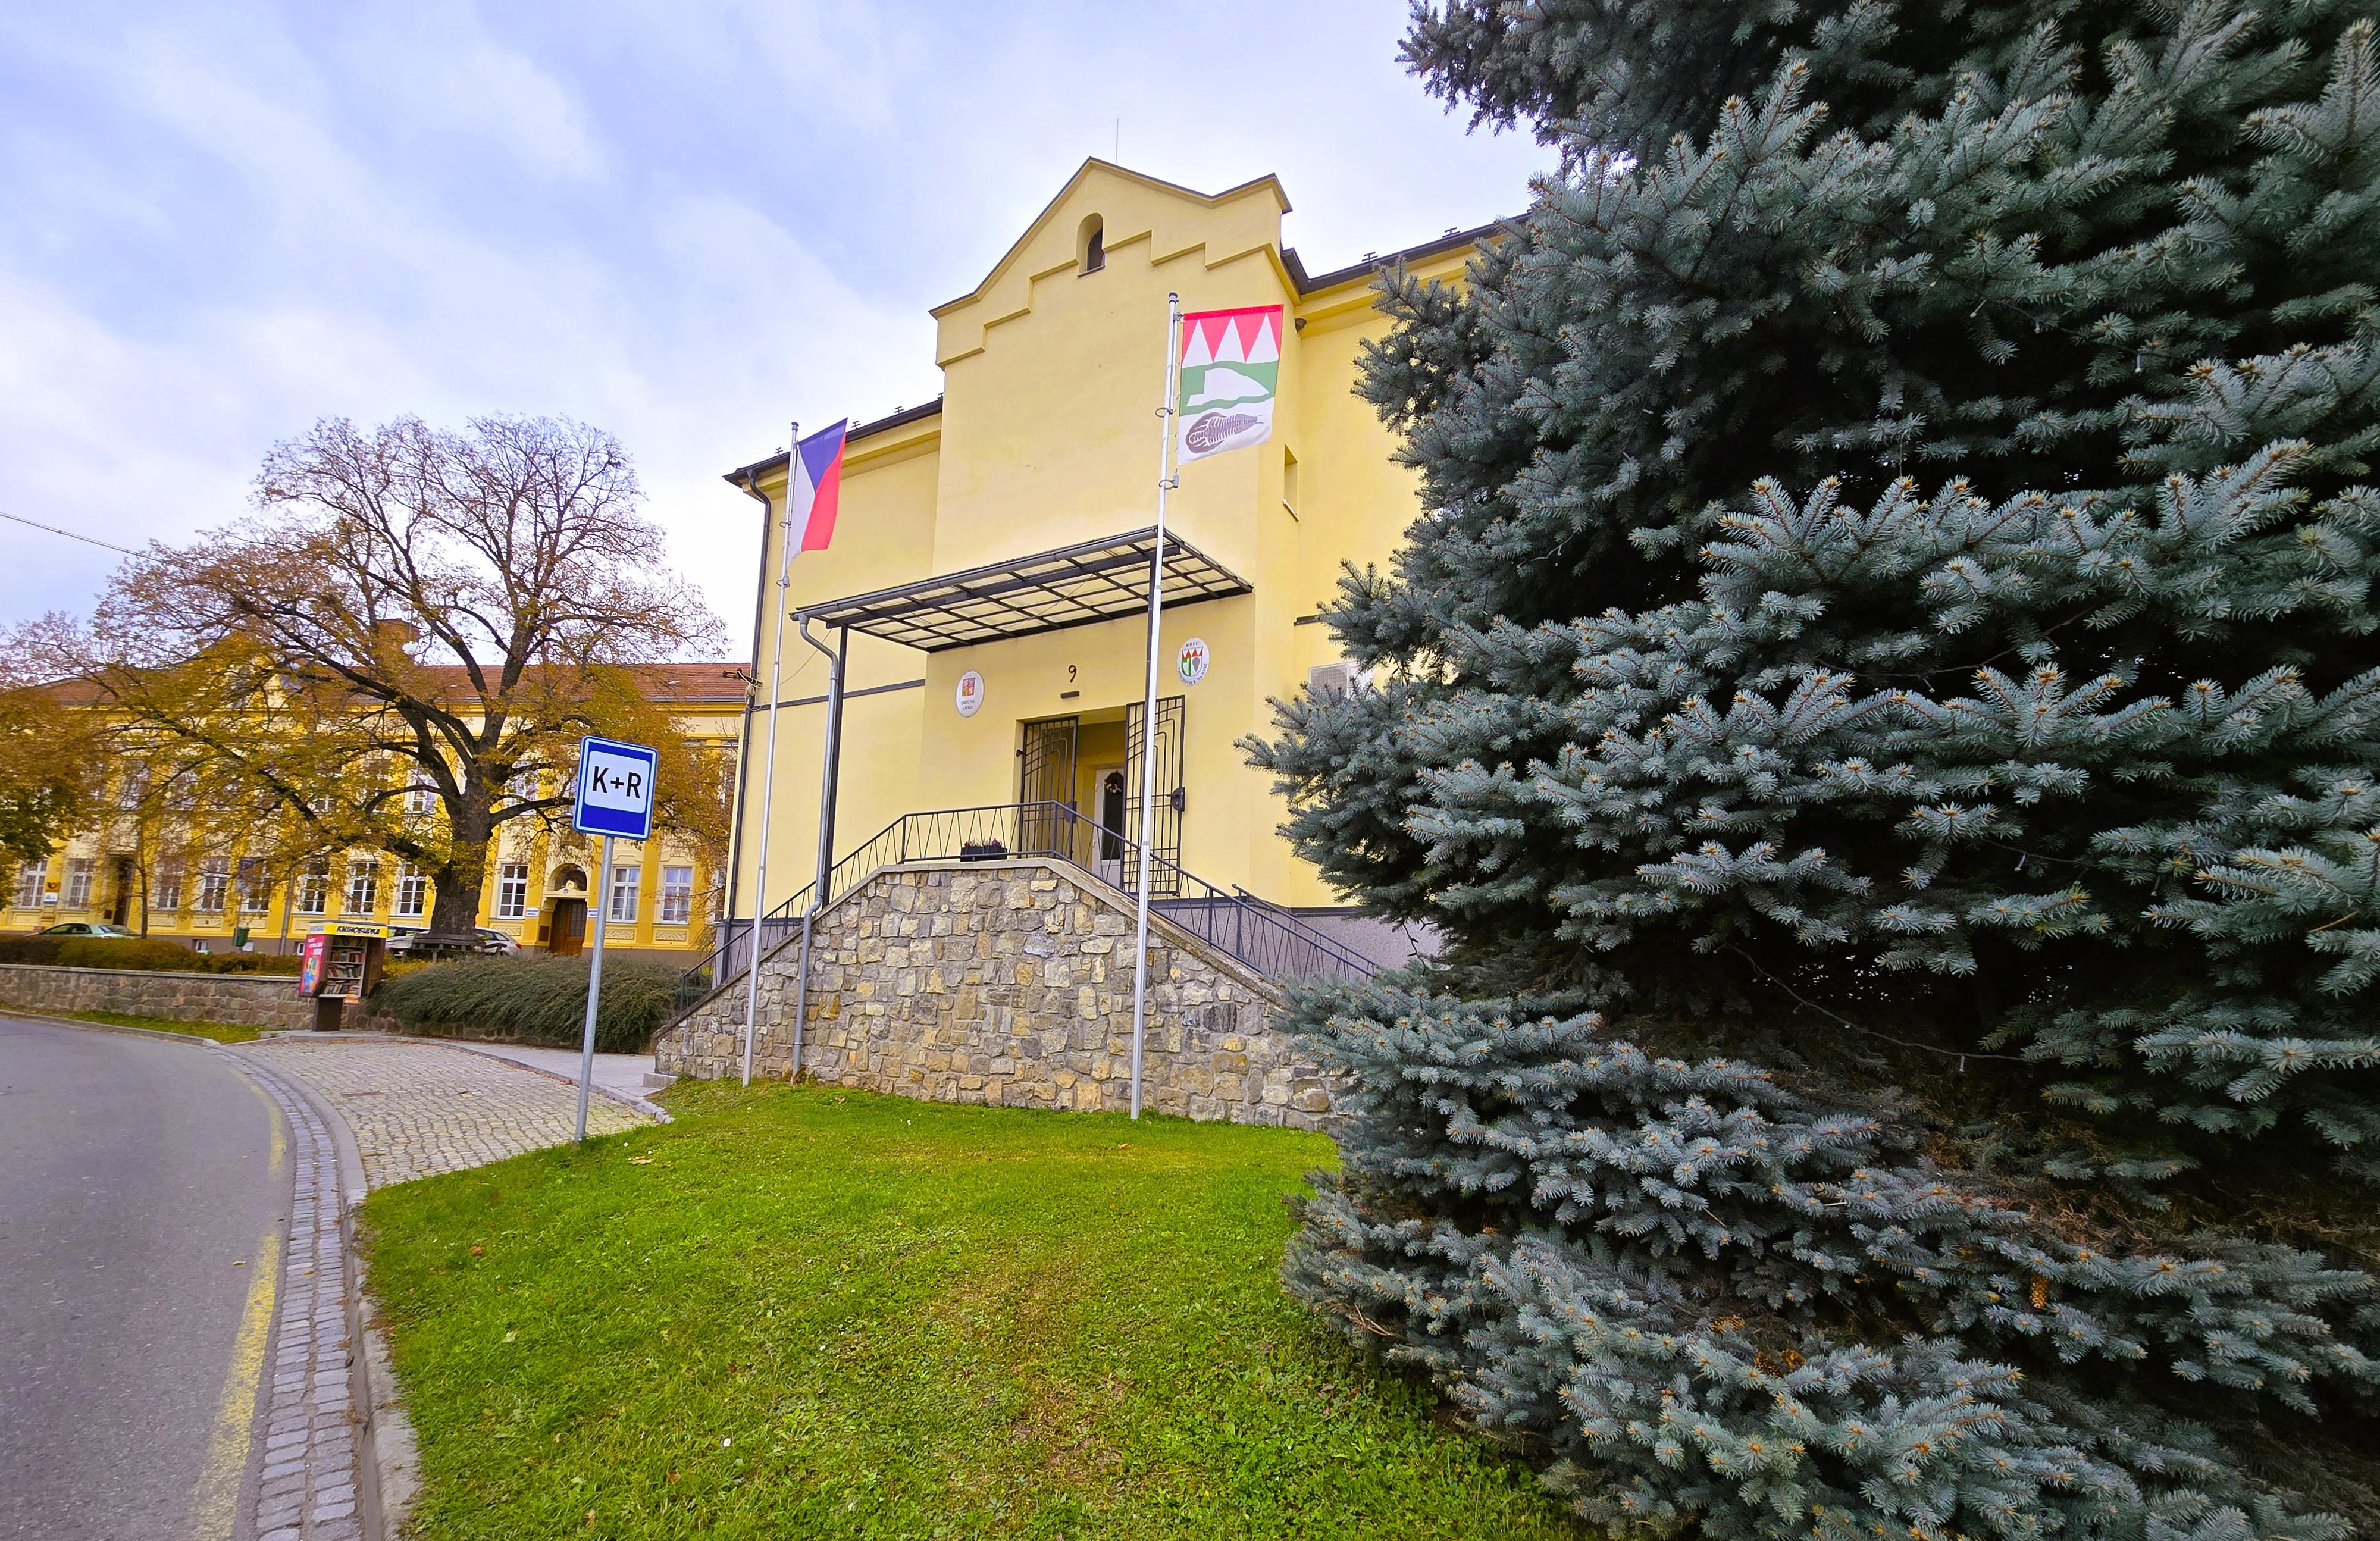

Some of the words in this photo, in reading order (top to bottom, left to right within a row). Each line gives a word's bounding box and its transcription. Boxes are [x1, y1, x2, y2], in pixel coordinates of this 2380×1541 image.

[1068, 665, 1076, 683] 9
[592, 766, 641, 798] K+R
[336, 926, 380, 935] KNIHOBUDKA
